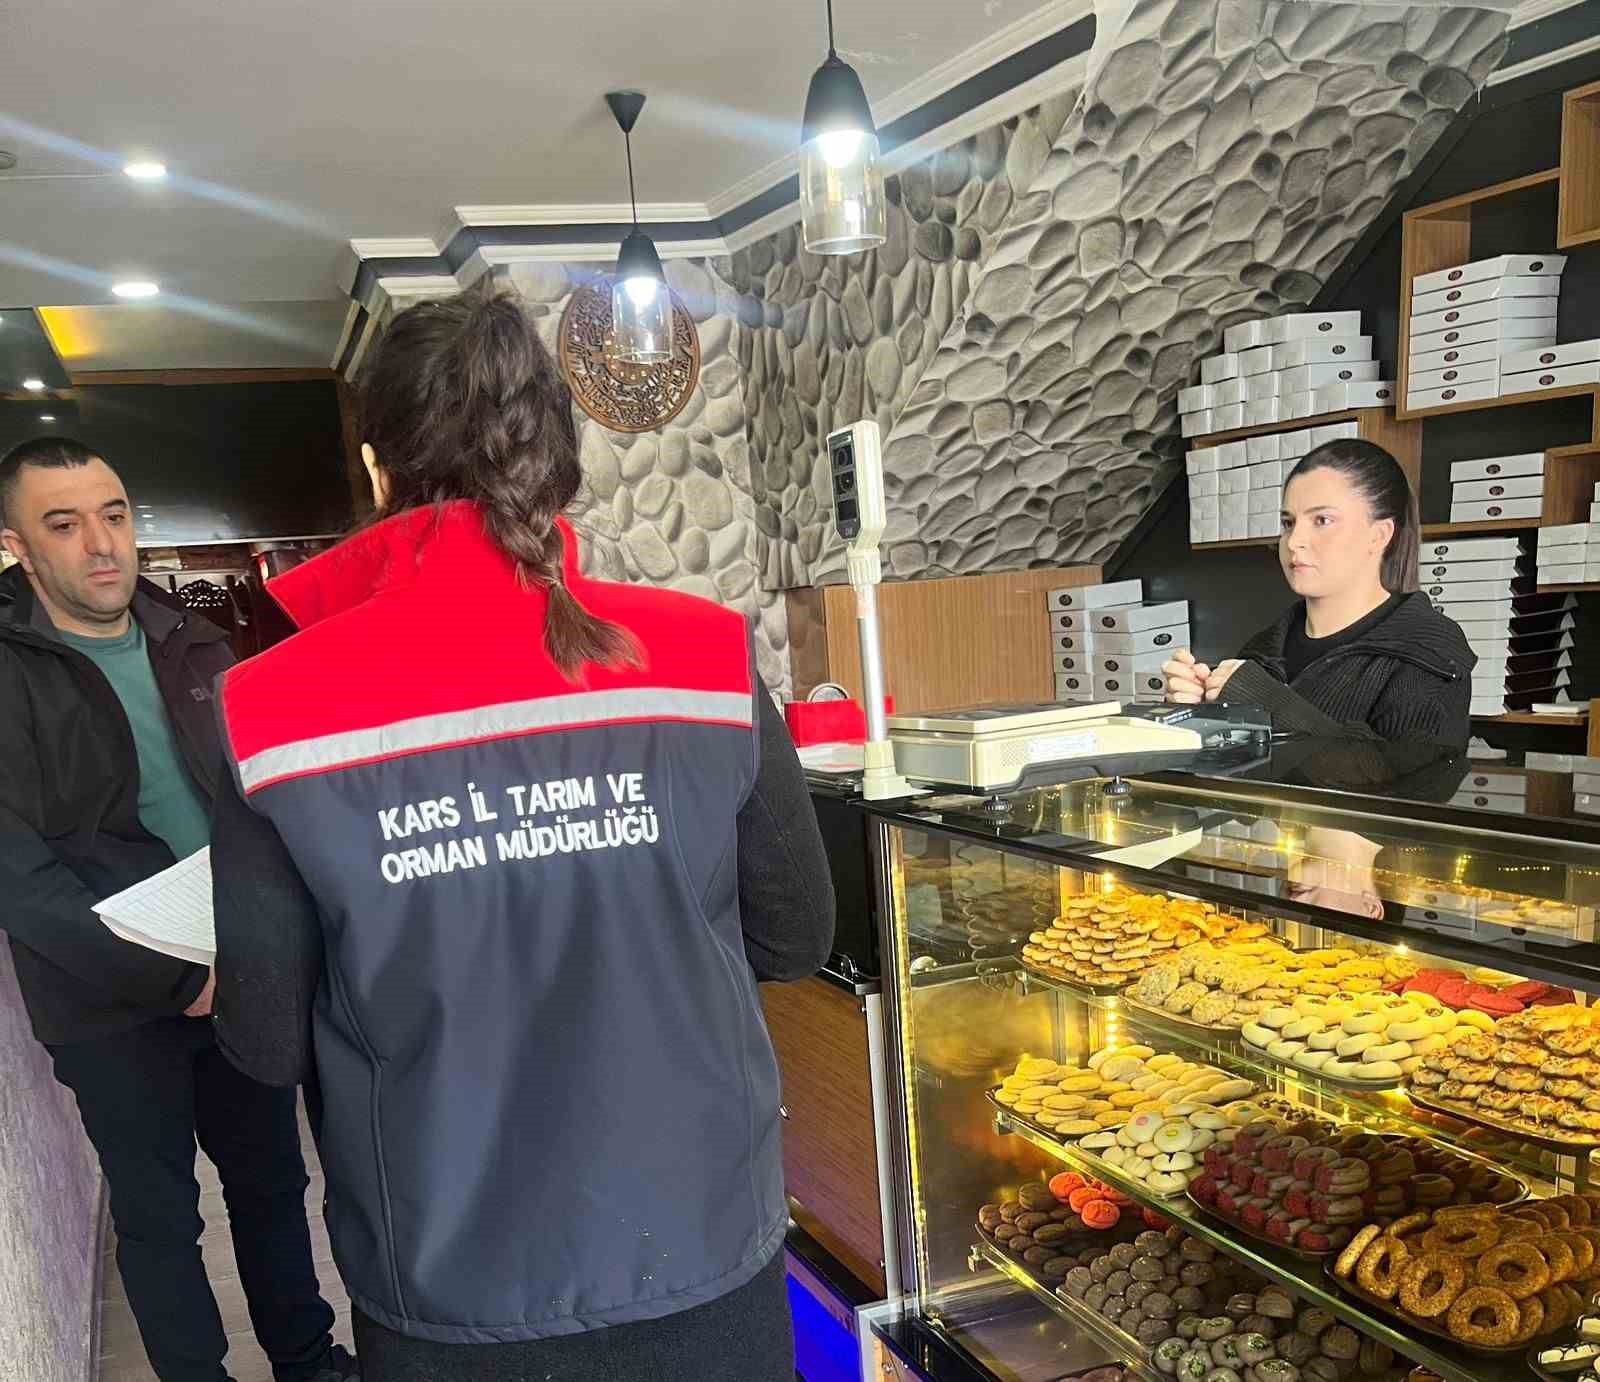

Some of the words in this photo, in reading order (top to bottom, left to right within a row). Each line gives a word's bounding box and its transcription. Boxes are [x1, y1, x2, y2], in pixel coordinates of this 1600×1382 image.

[378, 796, 461, 840] KARS
[467, 782, 498, 823] İL
[506, 777, 596, 816] TARIM
[607, 773, 645, 803] VE
[380, 836, 487, 884] ORMAN
[496, 806, 660, 862] MÜDÜRLÜĞÜ
